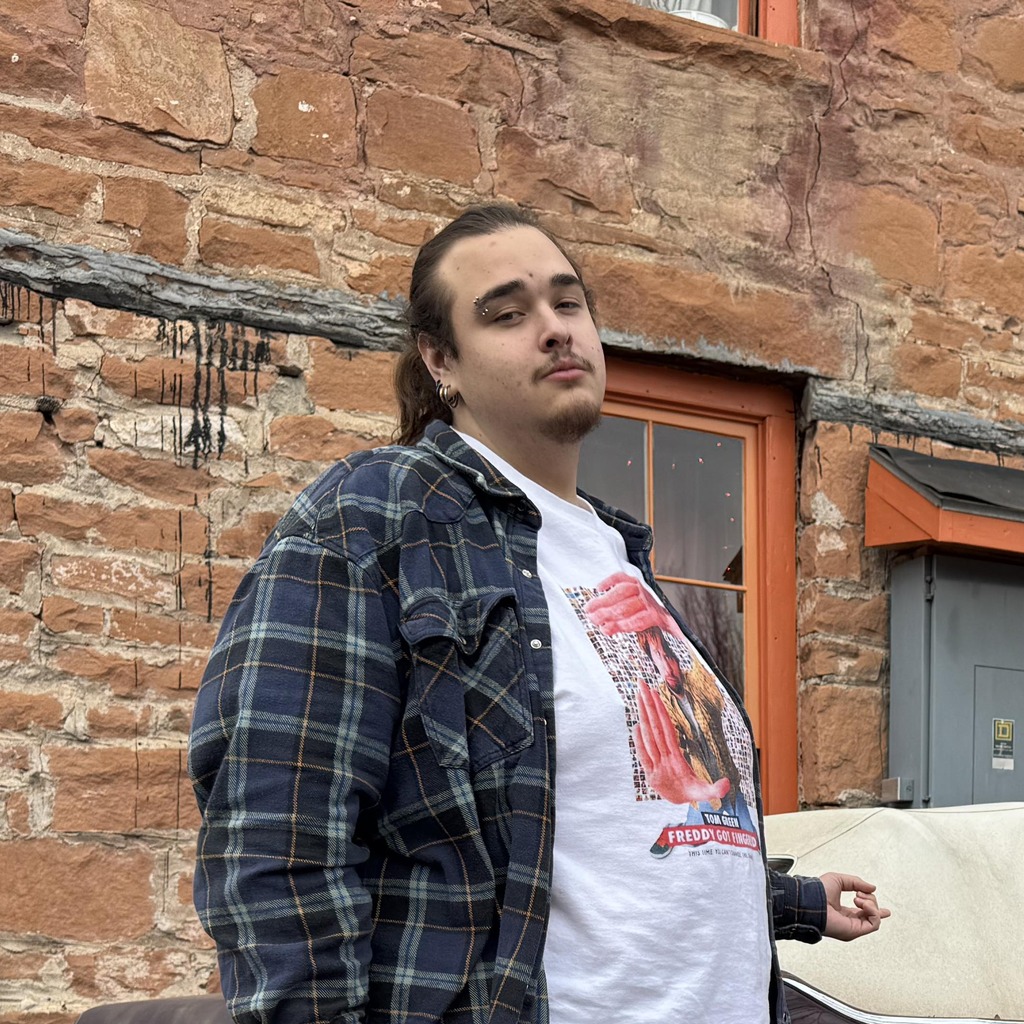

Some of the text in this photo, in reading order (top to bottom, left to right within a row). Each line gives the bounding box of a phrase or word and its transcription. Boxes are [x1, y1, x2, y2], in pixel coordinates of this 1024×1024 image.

[704, 813, 740, 828] TOM GREEN
[667, 828, 716, 844] FREDDY
[716, 830, 731, 842] GOT
